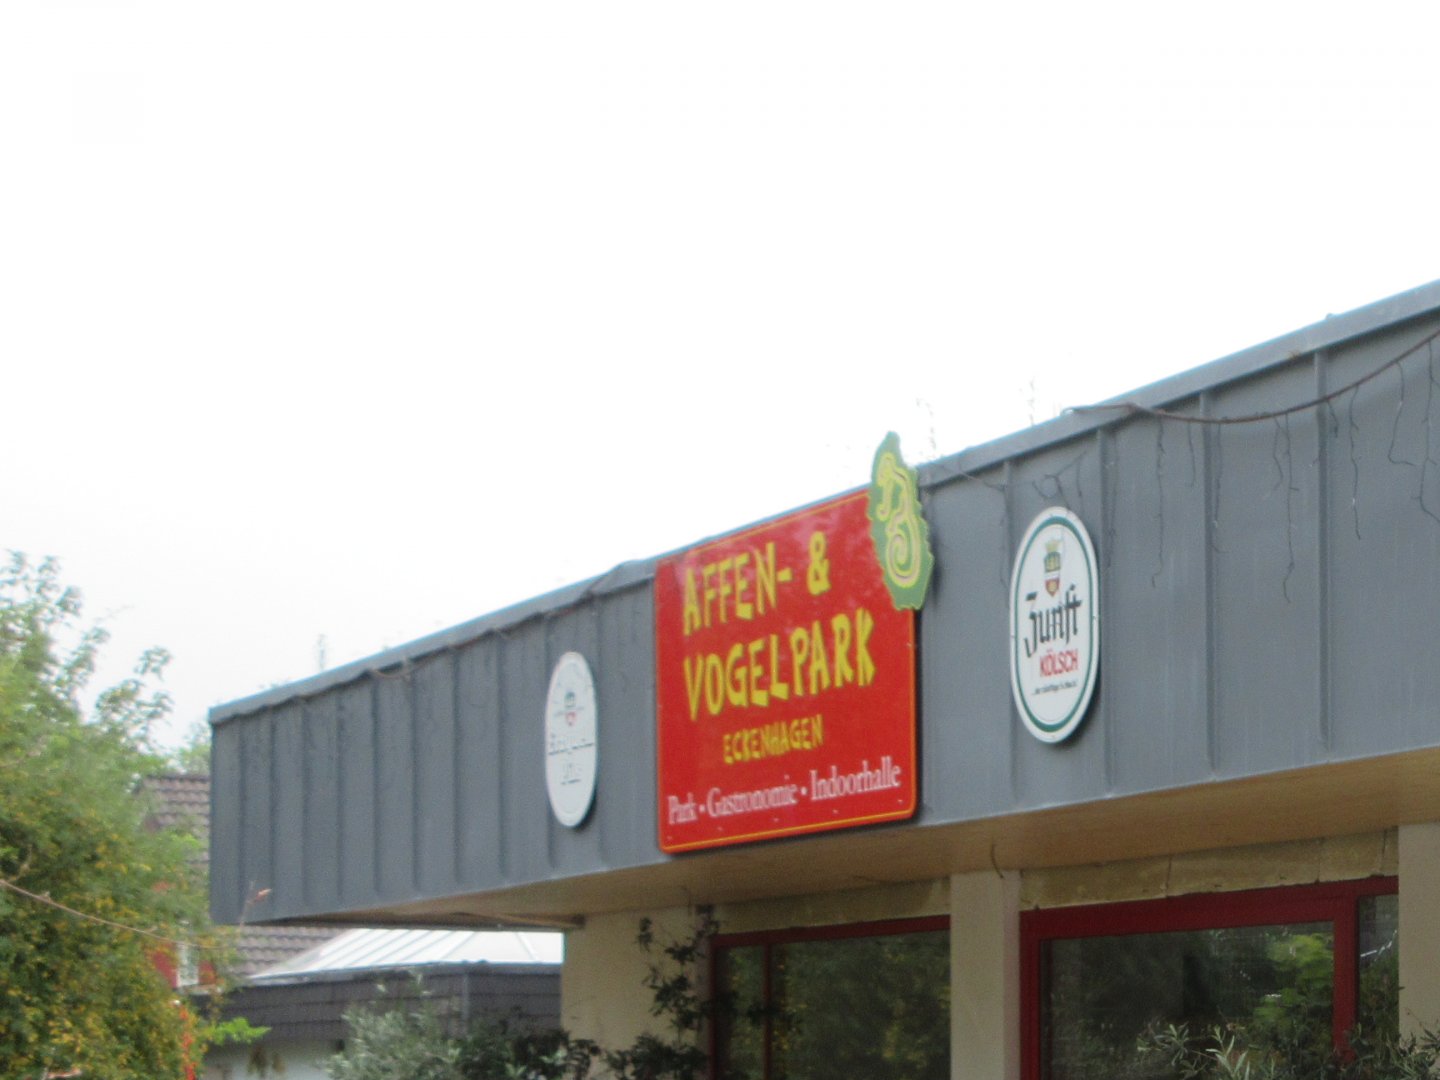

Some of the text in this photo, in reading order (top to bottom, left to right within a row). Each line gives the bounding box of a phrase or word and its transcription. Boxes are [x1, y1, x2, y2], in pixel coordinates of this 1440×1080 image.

[684, 530, 831, 636] AFFEN- &
[683, 608, 876, 721] VOGELPARK
[723, 714, 823, 765] ECKENHAGEN
[667, 755, 901, 825] Park Gastronomie Indoorhalle
